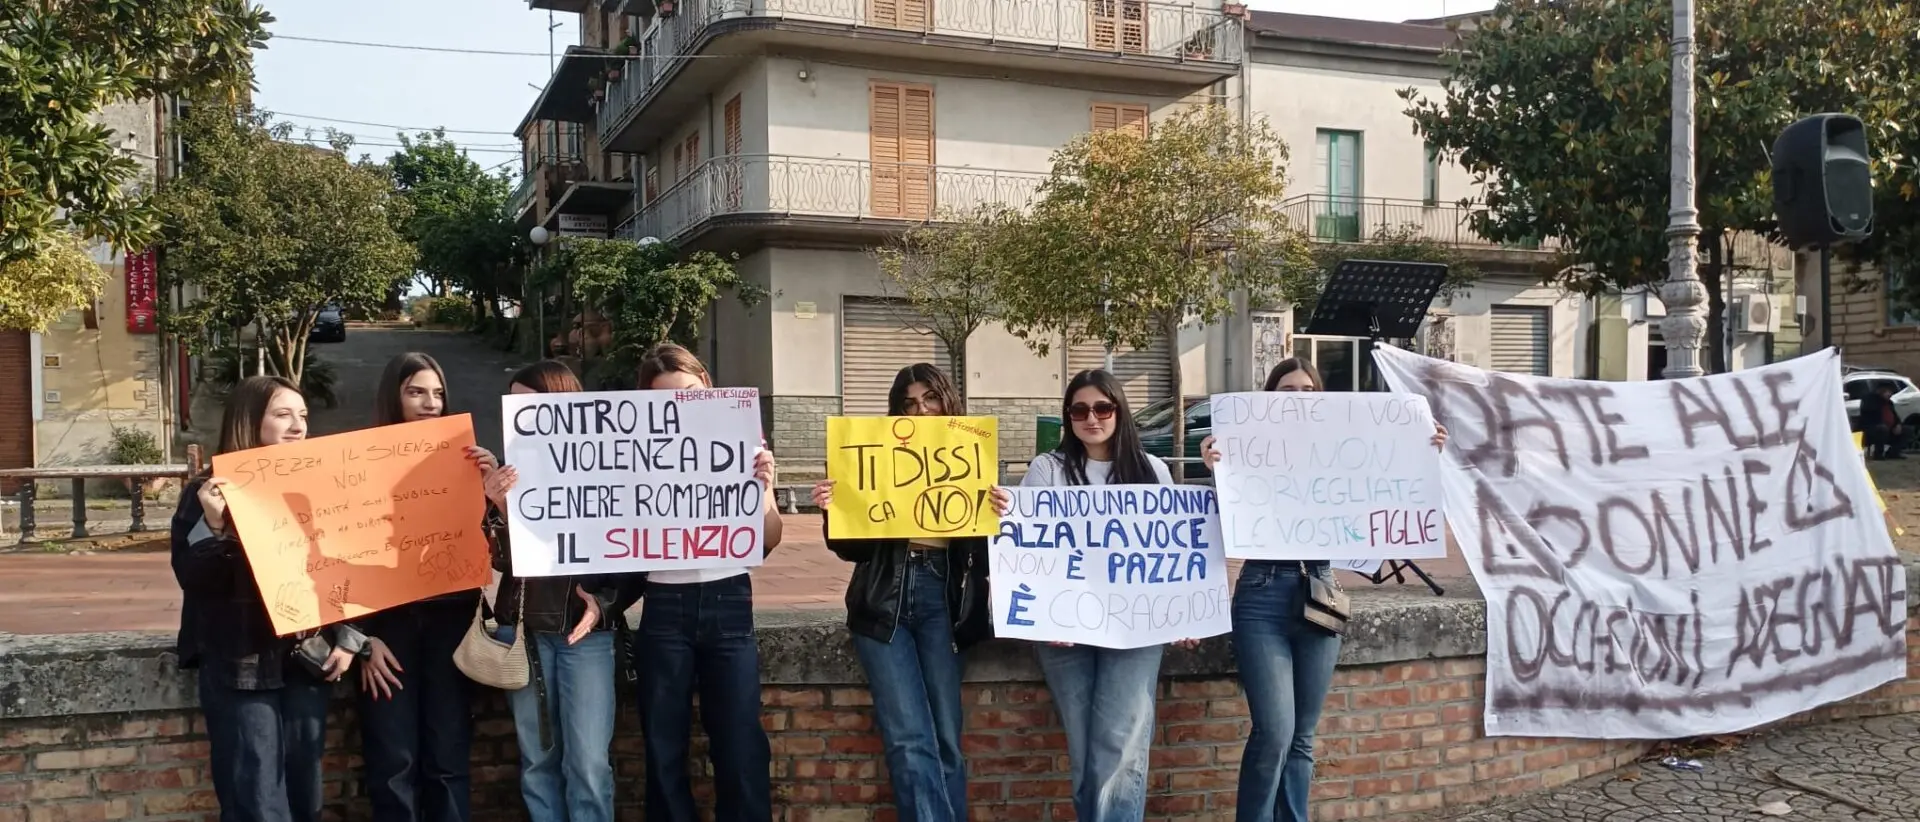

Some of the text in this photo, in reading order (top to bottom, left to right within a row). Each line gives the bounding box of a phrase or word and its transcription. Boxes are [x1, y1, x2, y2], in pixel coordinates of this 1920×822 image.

[130, 253, 139, 307] STICCERIA
[513, 399, 680, 436] CONTRO LA
[1213, 395, 1325, 425] EDUCATE
[1668, 371, 1806, 450] ALLE
[231, 440, 451, 491] SPEZZA IL SILENZIO
[548, 436, 745, 474] VIOLENZA DI
[840, 443, 982, 491] TI DISSI
[1309, 437, 1396, 471] NON
[333, 471, 367, 490] NON
[393, 487, 449, 503] SUBISCE
[1226, 472, 1426, 507] SORVEGLIATE
[518, 479, 760, 521] GENERE ROMPIAMO
[868, 501, 897, 523] CA
[1093, 489, 1138, 516] UNA
[1143, 486, 1219, 516] DONNA
[399, 530, 464, 552] GIUSTIZIA
[557, 524, 756, 565] IL SILENZIO
[993, 517, 1209, 549] ALZA LA VOCE
[1232, 508, 1438, 549] LE VOSTRE FIGLIE
[997, 549, 1207, 585] NON È PAZZA
[1006, 583, 1232, 635] È CORAGGIOSA
